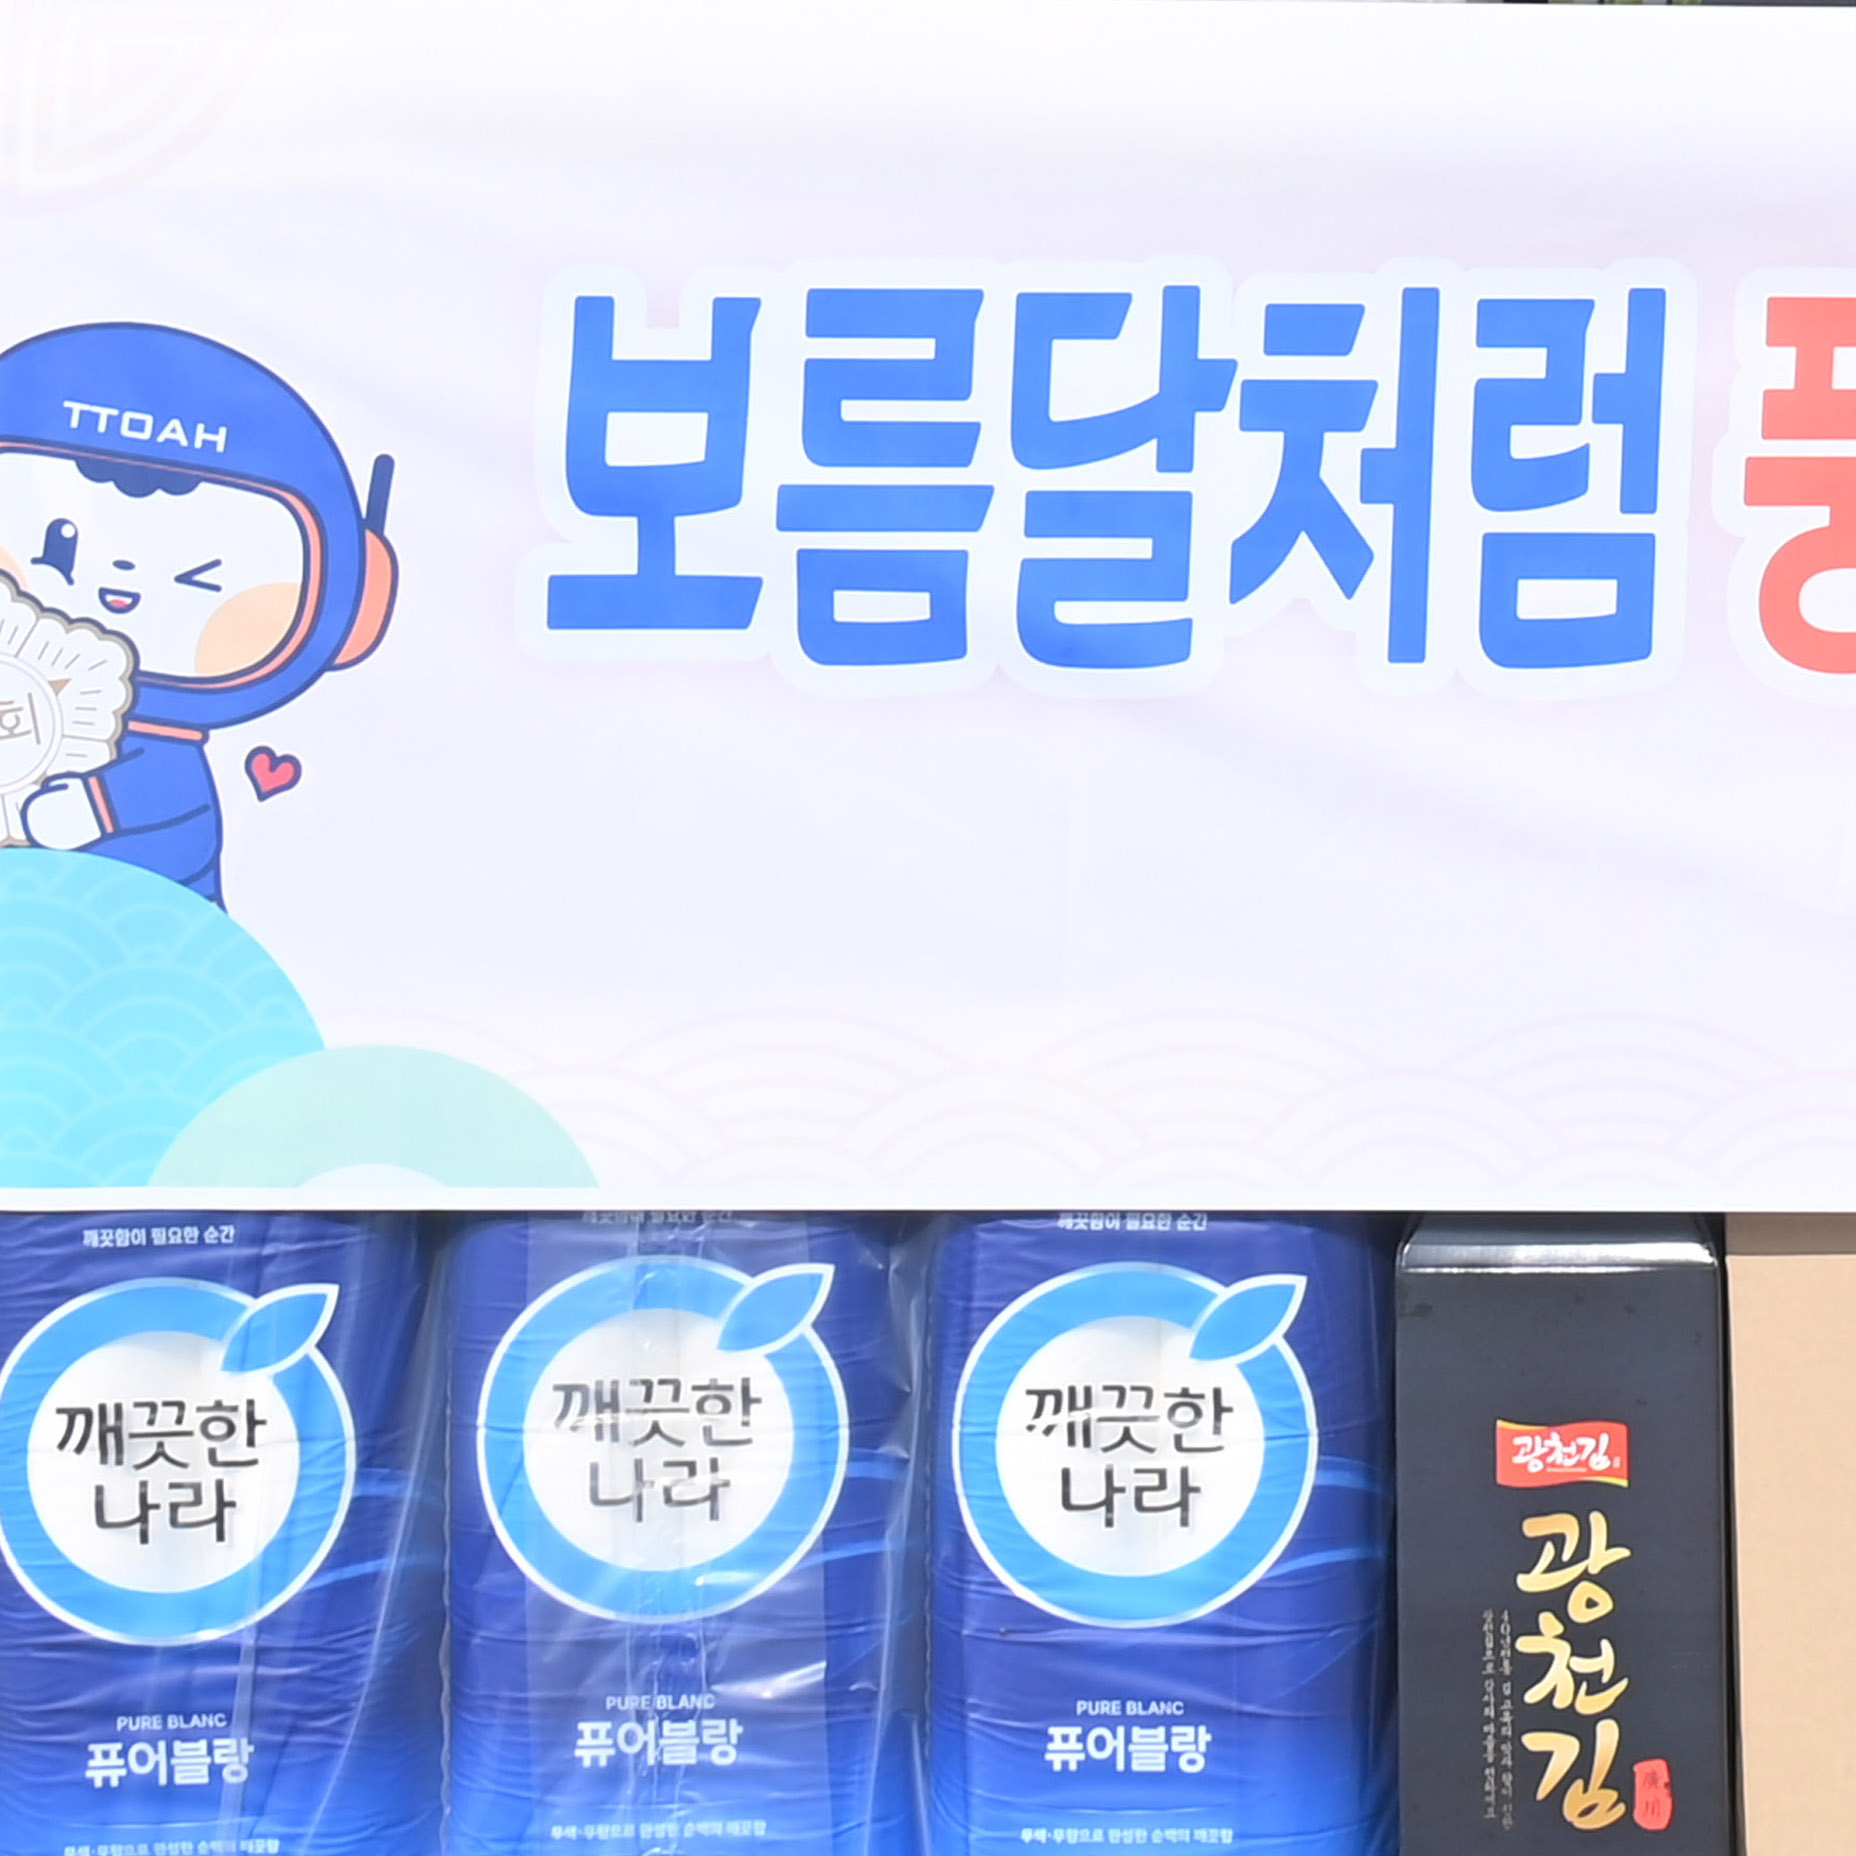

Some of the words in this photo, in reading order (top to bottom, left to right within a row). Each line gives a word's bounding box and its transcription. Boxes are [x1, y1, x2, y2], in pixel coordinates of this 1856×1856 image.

[63, 400, 228, 453] TTOAH
[546, 285, 1667, 670] 보름달처럼
[204, 1224, 235, 1244] 순간
[55, 1399, 268, 1471] 깨끗한
[552, 1377, 762, 1449] 깨끗한
[1025, 1384, 1233, 1454] 깨끗한
[1511, 1431, 1611, 1473] 광천김
[93, 1478, 236, 1544] 나라
[588, 1457, 730, 1522] 나라
[1061, 1464, 1201, 1528] 나라
[1516, 1511, 1631, 1830] 광천김
[116, 1715, 162, 1732] PURE
[167, 1713, 227, 1730] BLANC
[606, 1695, 650, 1711] PURE
[656, 1694, 715, 1710] BLANC
[1076, 1700, 1121, 1716] PURE
[1125, 1700, 1185, 1716] BLANC
[85, 1737, 255, 1788] 퓨어블랑
[574, 1718, 744, 1768] 퓨어블랑
[1044, 1725, 1212, 1774] 퓨어블랑
